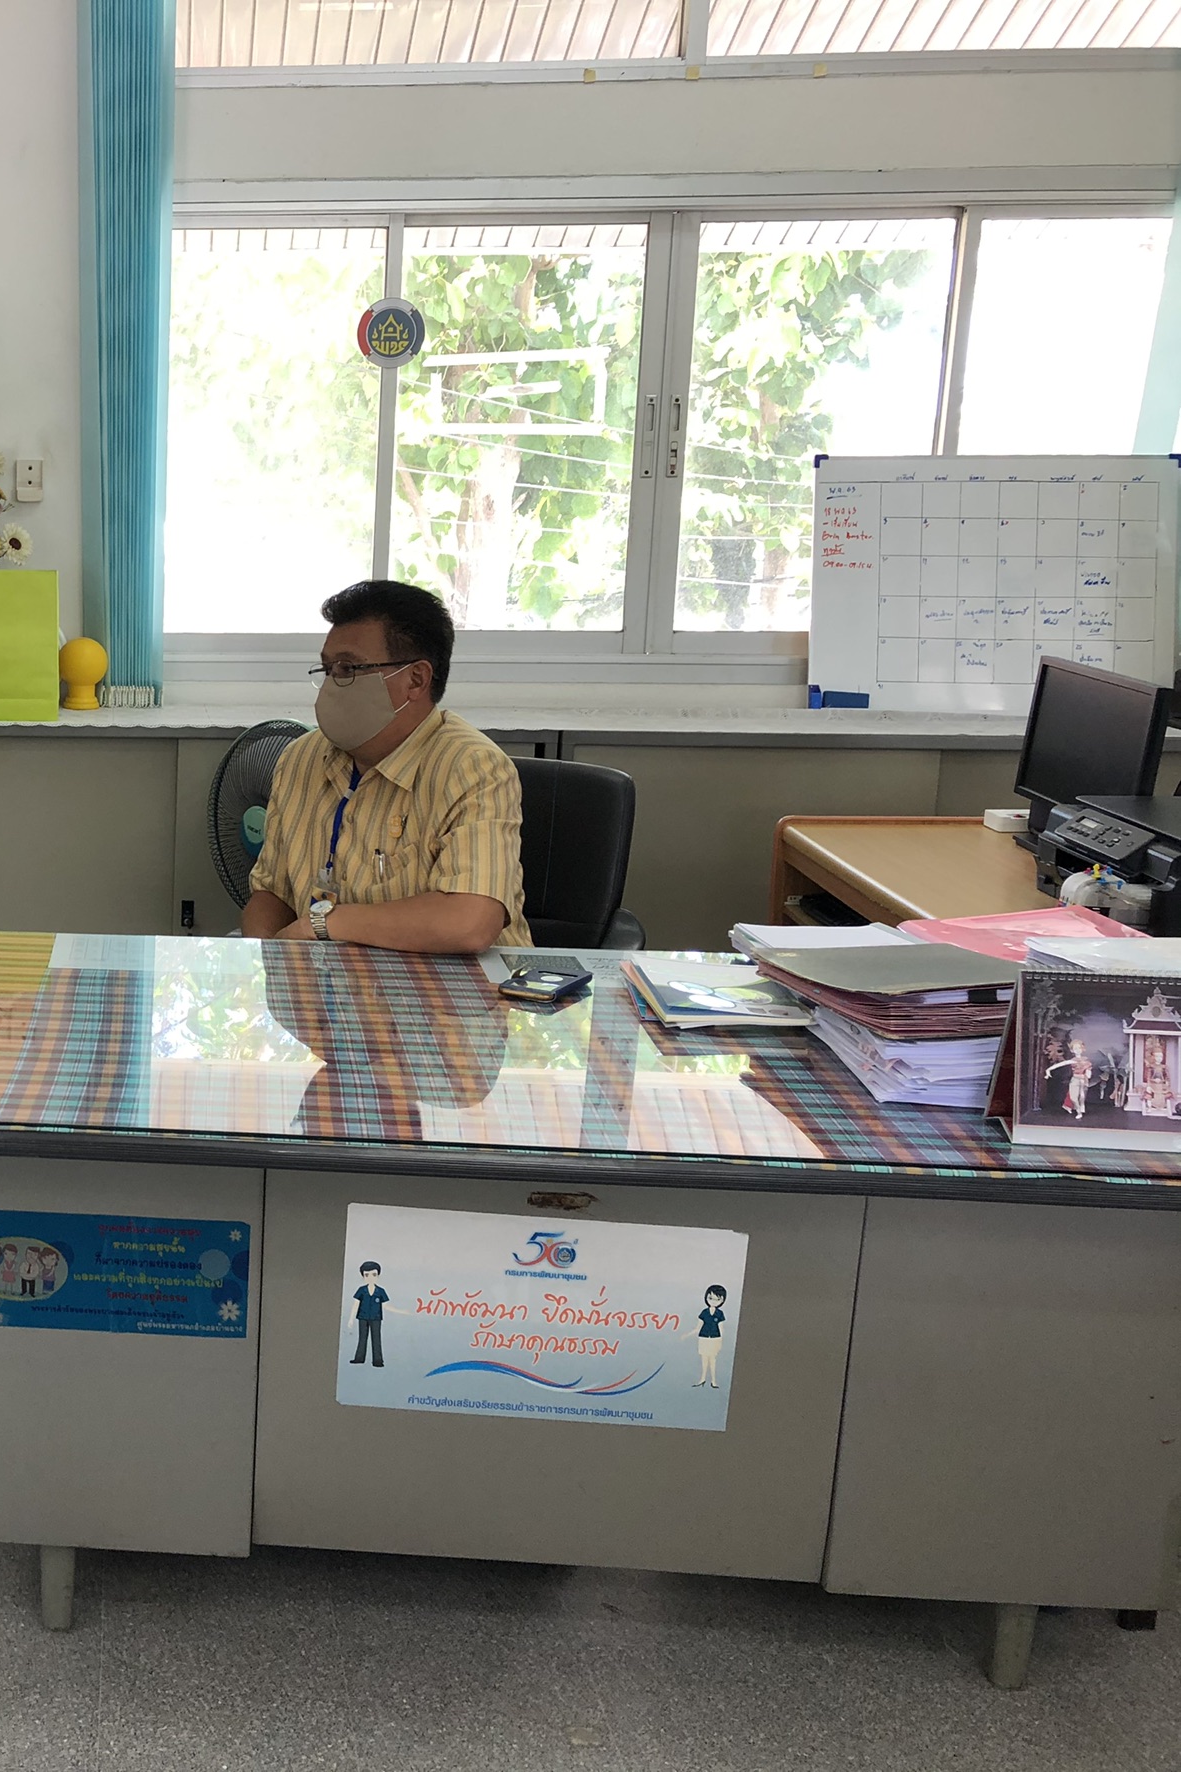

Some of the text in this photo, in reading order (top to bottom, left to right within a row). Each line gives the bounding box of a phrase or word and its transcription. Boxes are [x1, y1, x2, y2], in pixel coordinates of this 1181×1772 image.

[505, 1268, 587, 1281] กรมการพัฒนาชุมชน
[416, 1286, 680, 1330] นักพัฒนา ยึดมั่นจรรยา
[470, 1320, 620, 1365] รักษาคุณธรรม
[407, 1394, 654, 1421] คำขวัญส่งเสริมจริยธรรมข้าราชการกรมการพัฒนาชุมชน
